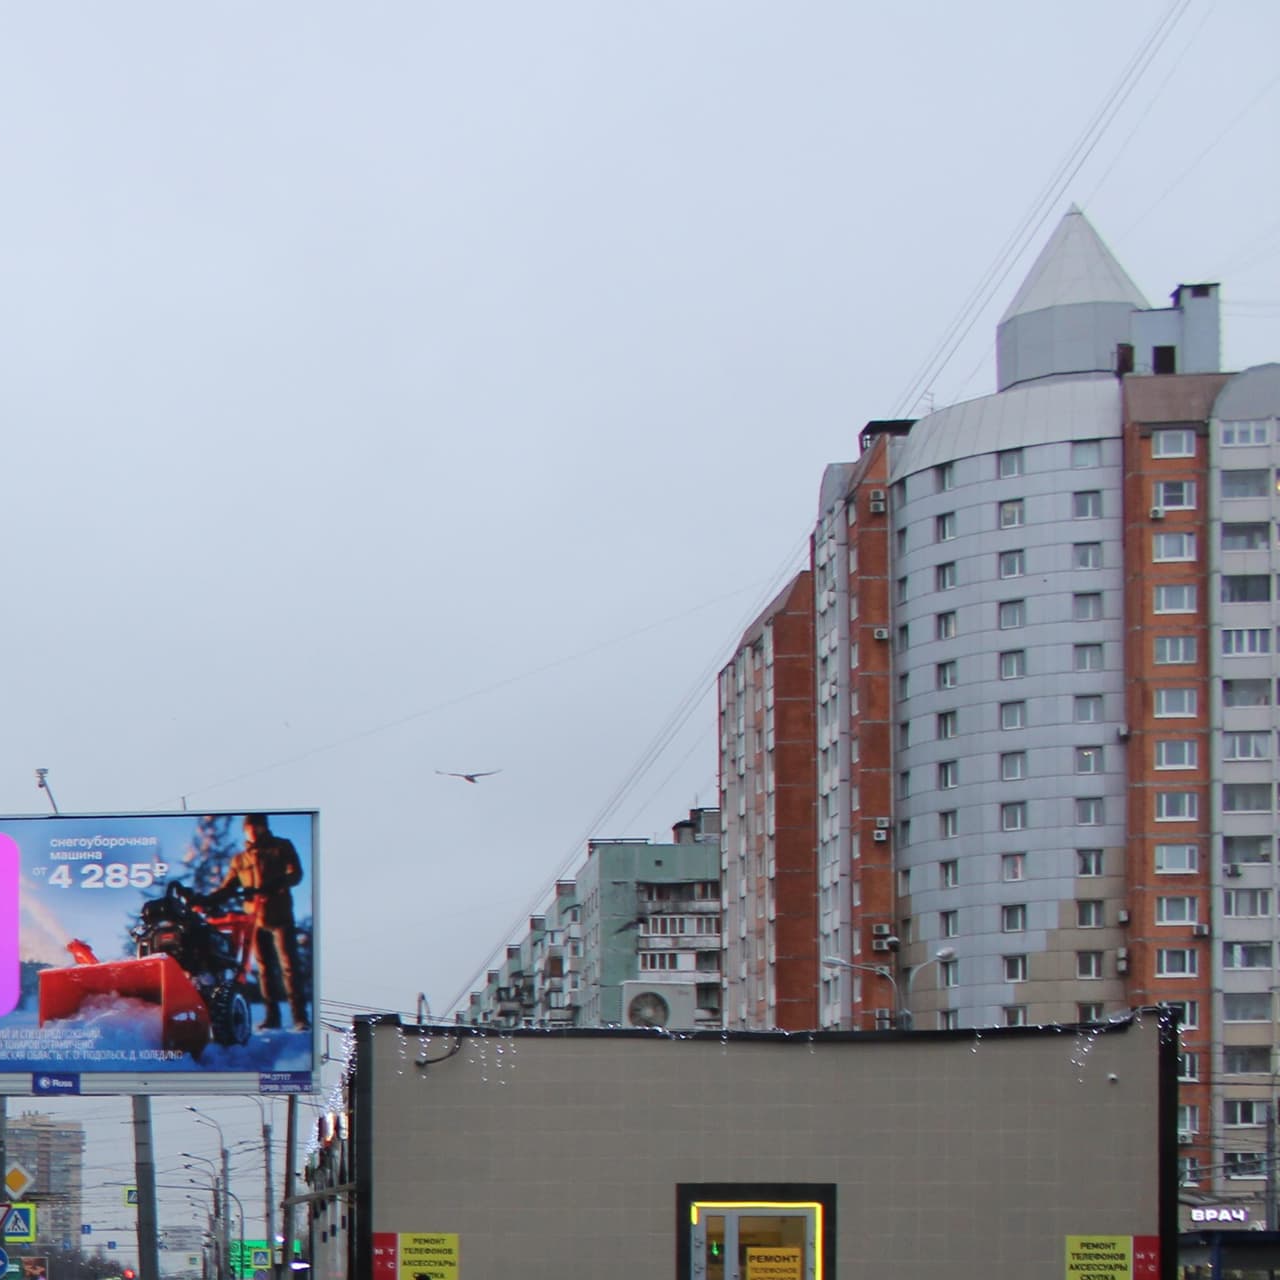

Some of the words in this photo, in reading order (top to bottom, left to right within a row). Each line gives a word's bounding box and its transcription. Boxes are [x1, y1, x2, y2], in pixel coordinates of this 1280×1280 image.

[50, 836, 157, 848] снегоуборочная
[50, 850, 103, 861] машина
[32, 867, 49, 877] от
[52, 1079, 73, 1088] Russ
[1191, 1208, 1246, 1222] ВРАЧ
[1080, 1242, 1116, 1250] РЕМОНТ
[403, 1247, 453, 1255] ТЕЛЕФОНОВ
[749, 1255, 799, 1264] РЕМОНТ
[1071, 1252, 1126, 1261] ТЕЛЕФОНОВ
[402, 1259, 456, 1267] АКСЕССУАРЫ
[1069, 1264, 1128, 1272] АКСЕССУАРЫ
